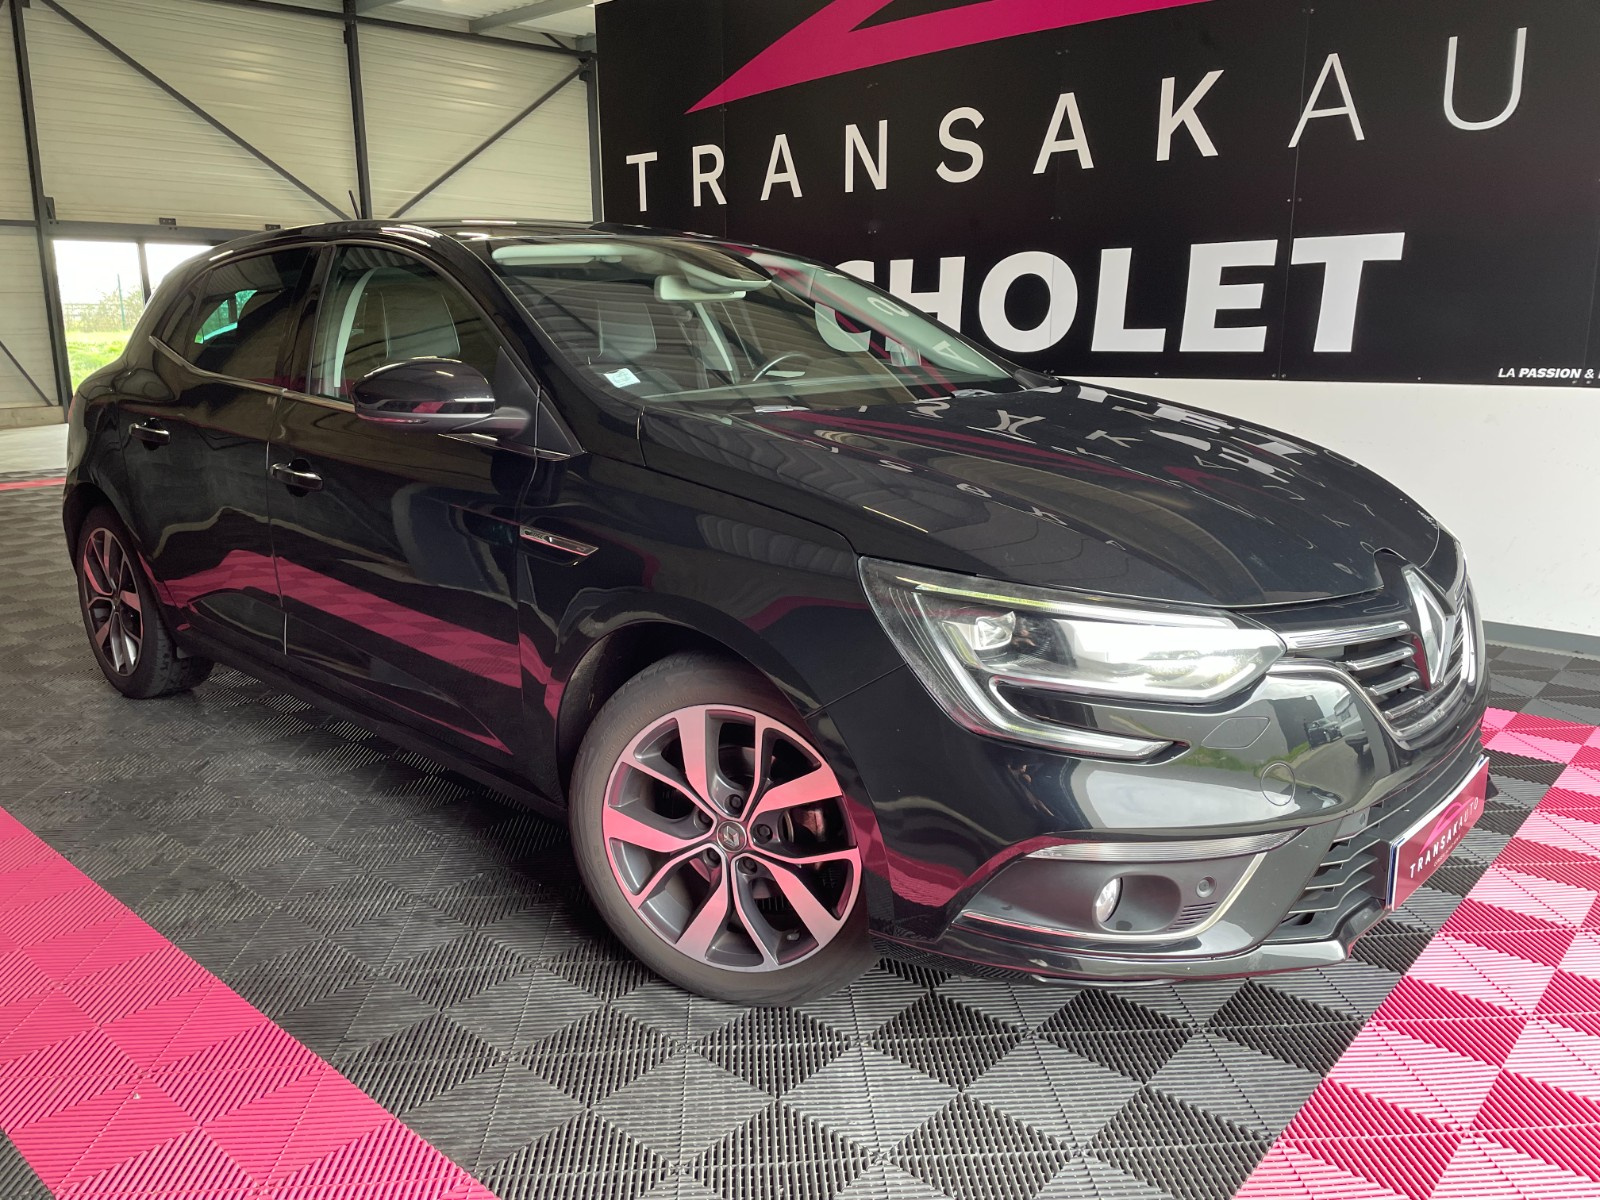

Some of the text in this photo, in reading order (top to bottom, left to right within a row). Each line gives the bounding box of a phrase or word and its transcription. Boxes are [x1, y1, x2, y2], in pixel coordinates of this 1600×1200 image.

[814, 231, 1406, 353] CHOLET
[1498, 367, 1516, 378] LA
[1518, 367, 1582, 379] PASSION
[1584, 368, 1595, 379] &
[1410, 796, 1479, 879] TRANSAKAUTO
